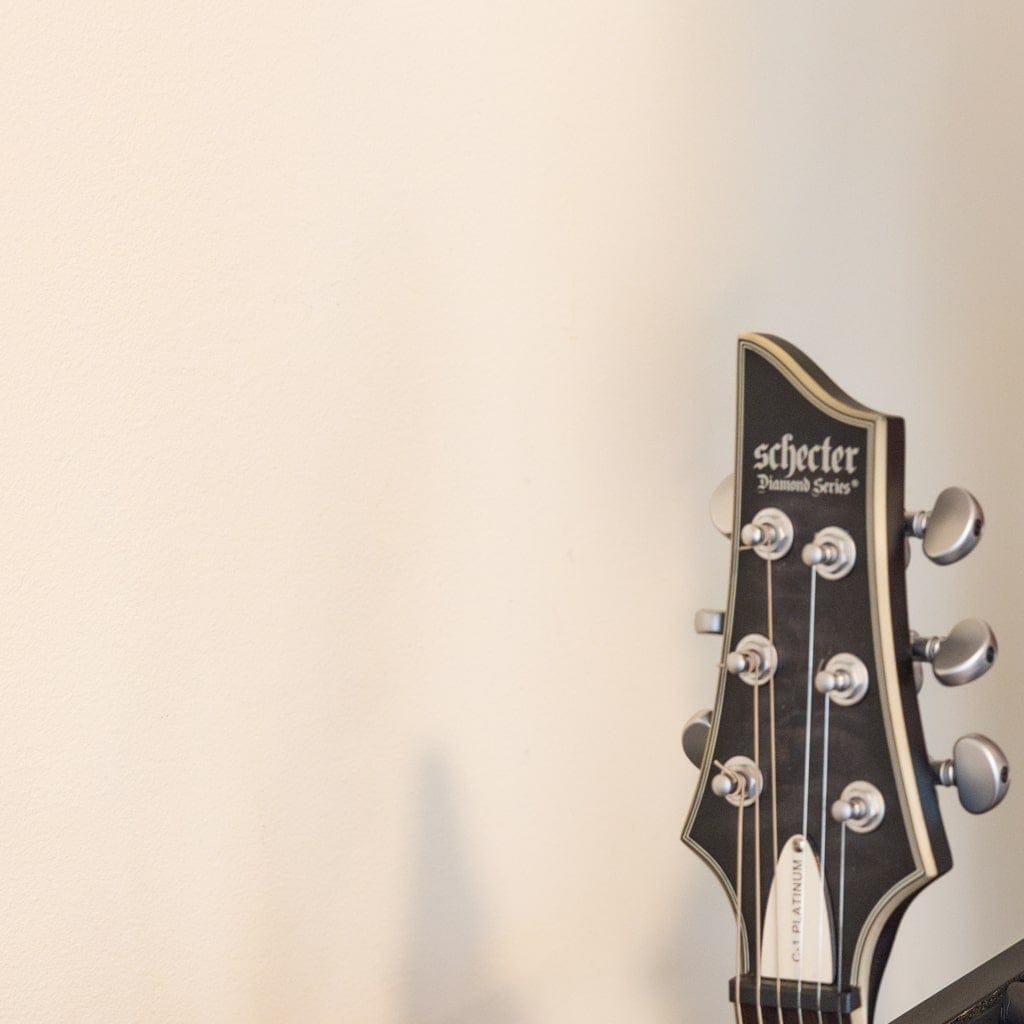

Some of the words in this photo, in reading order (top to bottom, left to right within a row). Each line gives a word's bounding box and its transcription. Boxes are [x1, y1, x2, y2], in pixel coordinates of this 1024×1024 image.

[753, 433, 860, 478] schecter
[757, 474, 811, 494] Diamond
[813, 477, 851, 497] Series
[792, 859, 803, 932] PLATINUM
